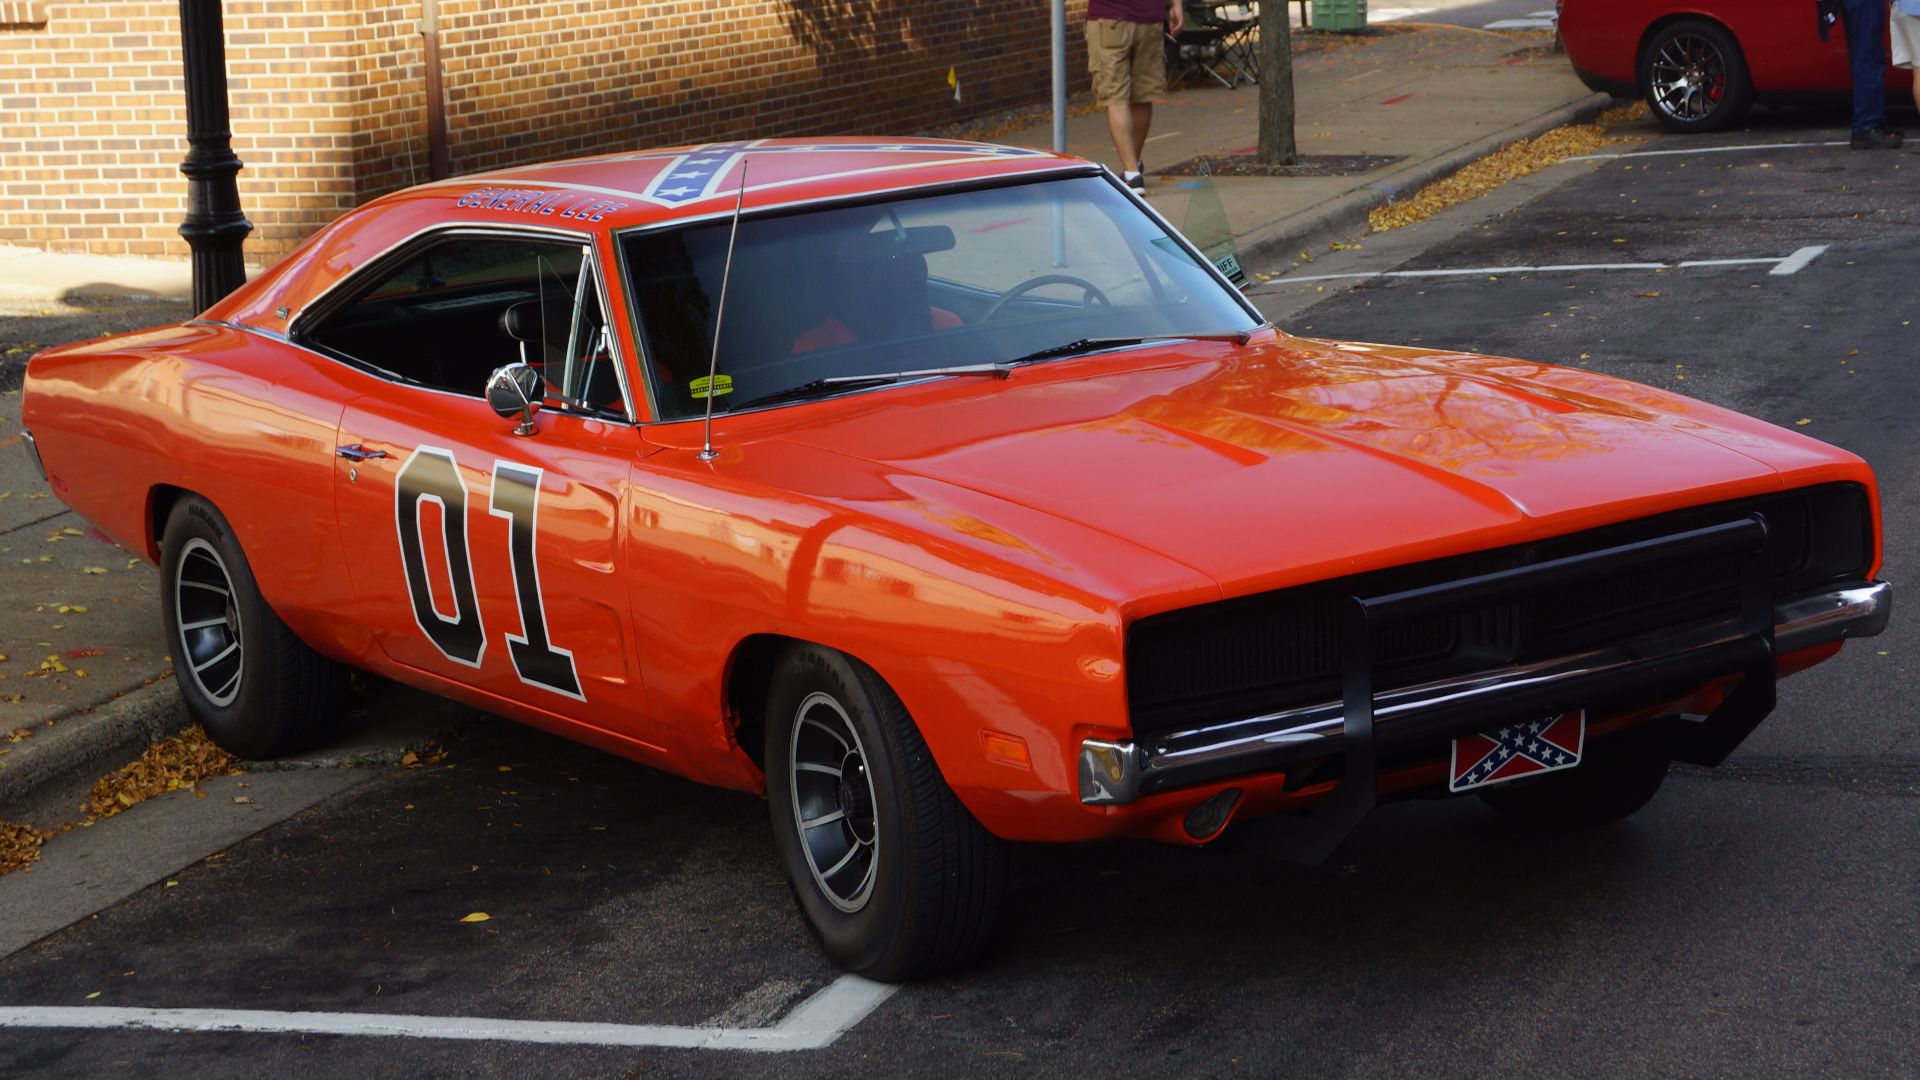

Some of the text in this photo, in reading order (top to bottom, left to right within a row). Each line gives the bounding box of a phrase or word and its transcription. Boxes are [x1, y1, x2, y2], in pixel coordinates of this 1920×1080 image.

[457, 187, 629, 223] GENERAL LEE
[395, 444, 587, 702] 01
